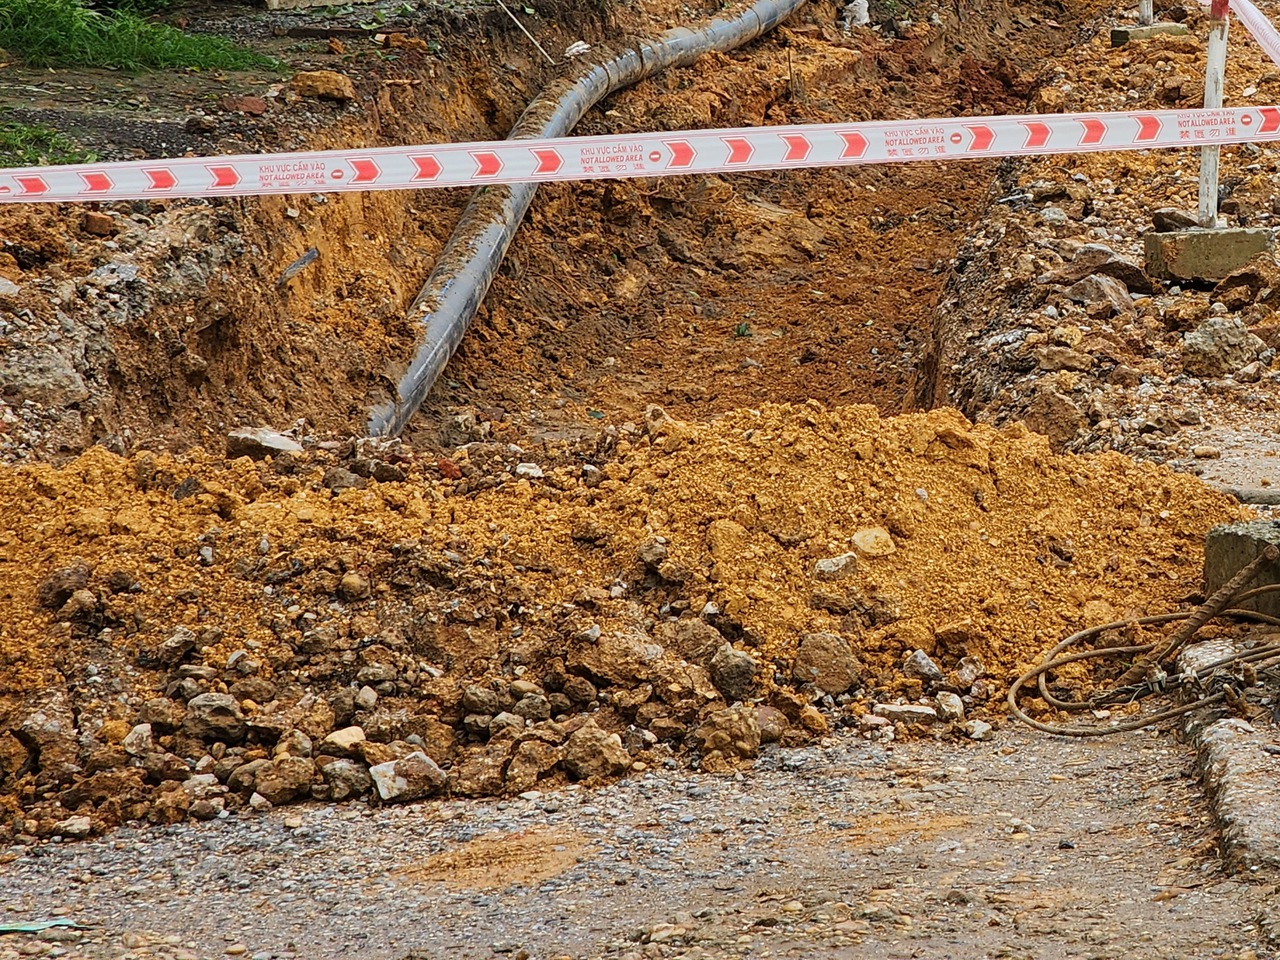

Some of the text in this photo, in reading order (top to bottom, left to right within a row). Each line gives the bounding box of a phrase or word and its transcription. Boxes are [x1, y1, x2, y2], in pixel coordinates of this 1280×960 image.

[915, 126, 929, 136] CẤM
[900, 138, 927, 146] ALLOWED
[928, 136, 945, 144] AREA
[612, 143, 627, 153] CẤM
[628, 143, 643, 152] VÀO
[259, 165, 274, 173] KHU
[293, 161, 308, 171] CẤM
[310, 161, 325, 171] VÀO
